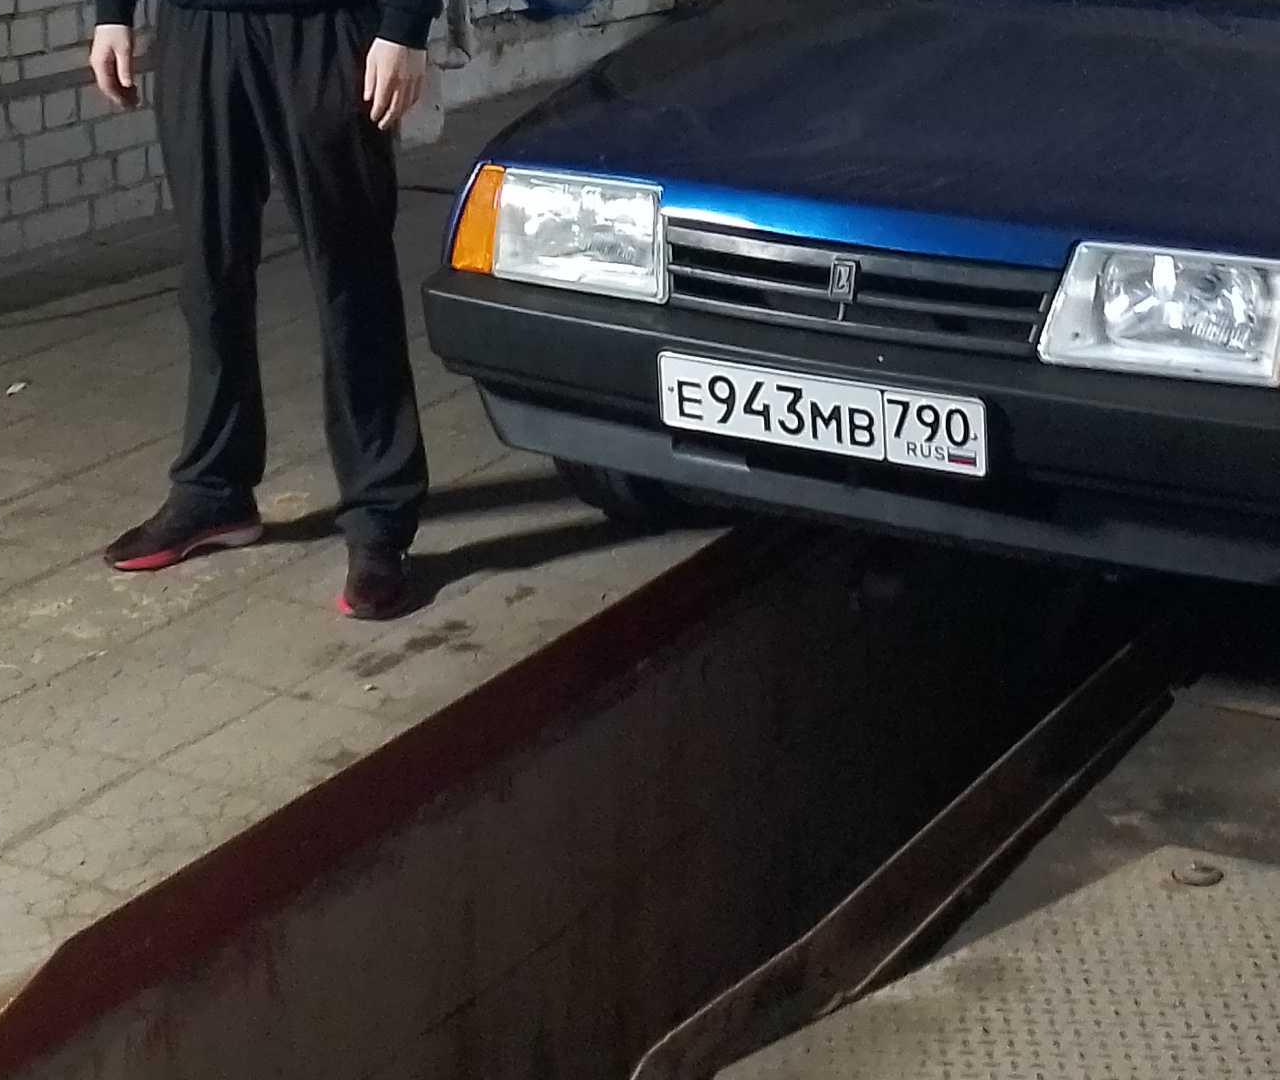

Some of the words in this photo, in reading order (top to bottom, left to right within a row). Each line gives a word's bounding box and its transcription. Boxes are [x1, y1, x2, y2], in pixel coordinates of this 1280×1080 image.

[677, 375, 876, 448] Е943МВ
[886, 399, 971, 447] 790
[906, 441, 945, 461] RUS
